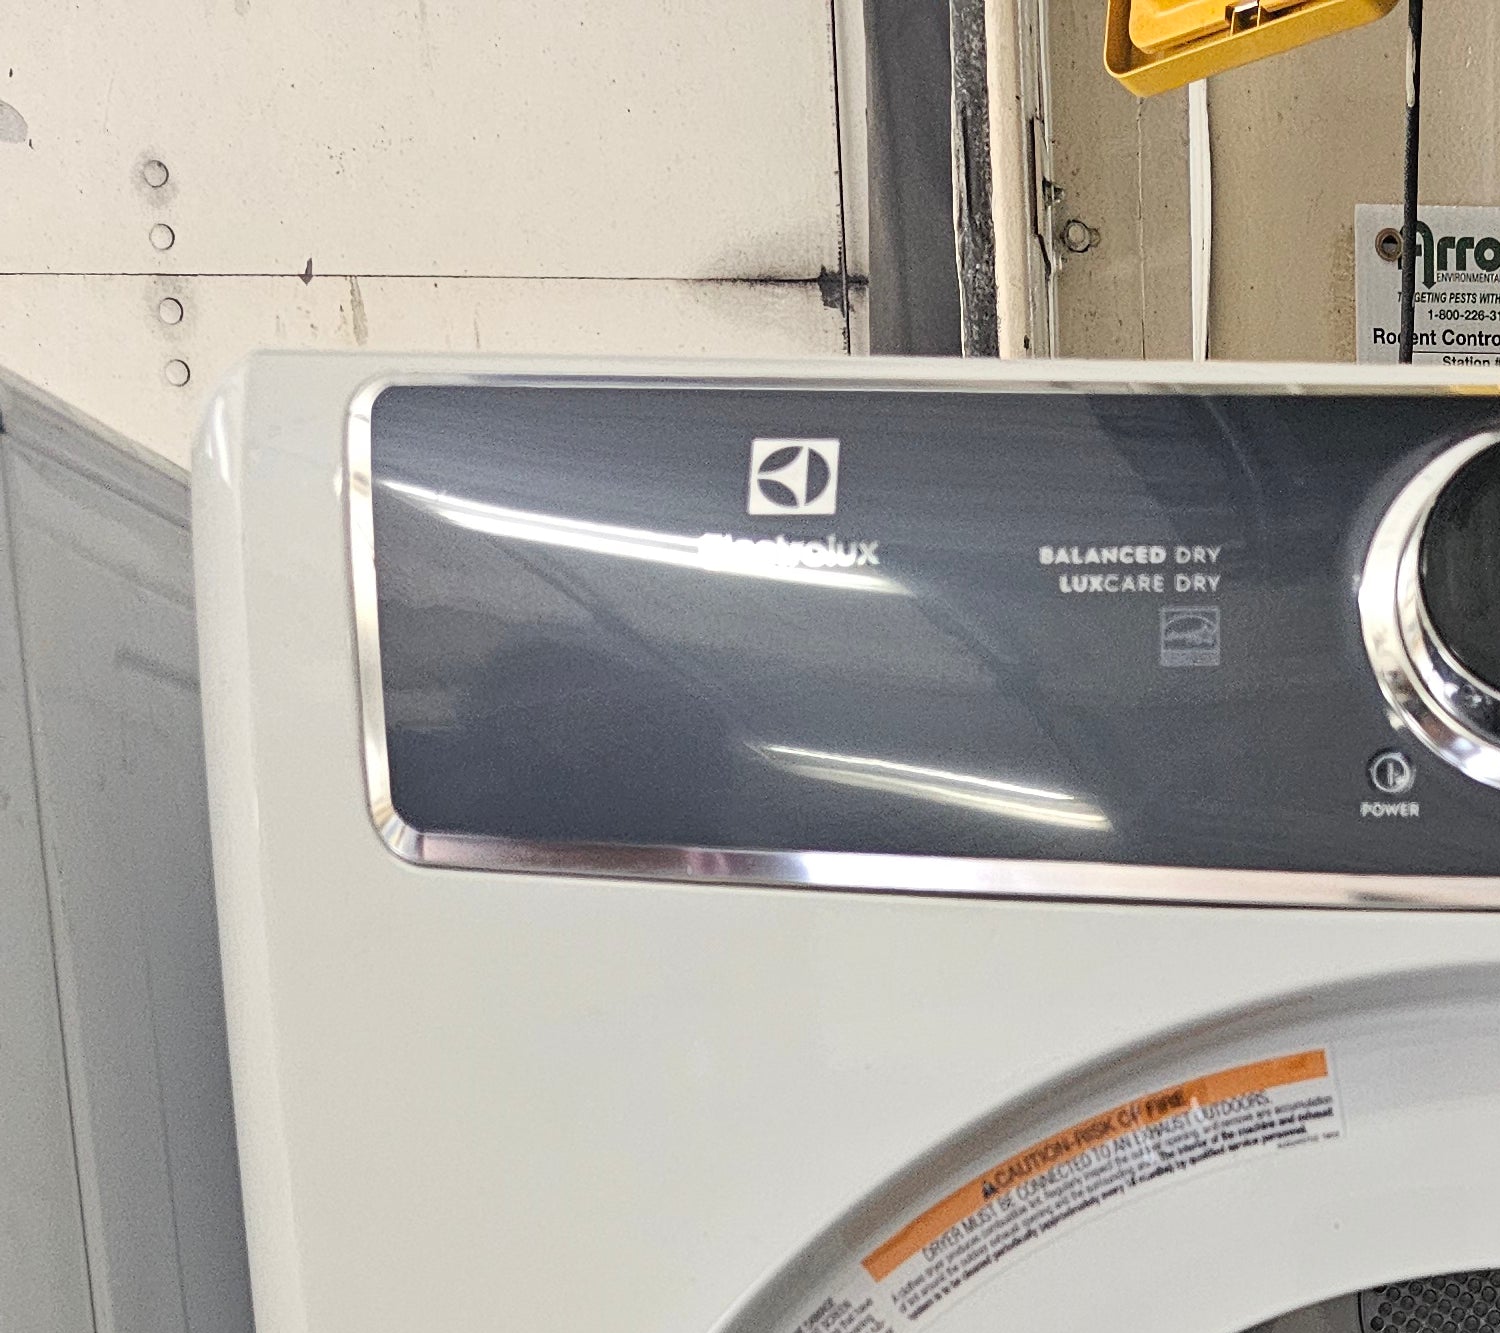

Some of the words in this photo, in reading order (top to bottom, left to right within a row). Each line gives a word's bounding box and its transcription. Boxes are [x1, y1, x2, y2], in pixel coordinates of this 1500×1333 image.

[1397, 291, 1447, 304] TGETING
[1449, 292, 1478, 304] PESTS
[1373, 328, 1437, 346] Roent
[1039, 545, 1167, 565] BALANCED
[1174, 545, 1222, 565] DRY
[1059, 573, 1165, 593] LUXCARE
[1174, 573, 1221, 593] DRY
[1360, 801, 1420, 818] POWER
